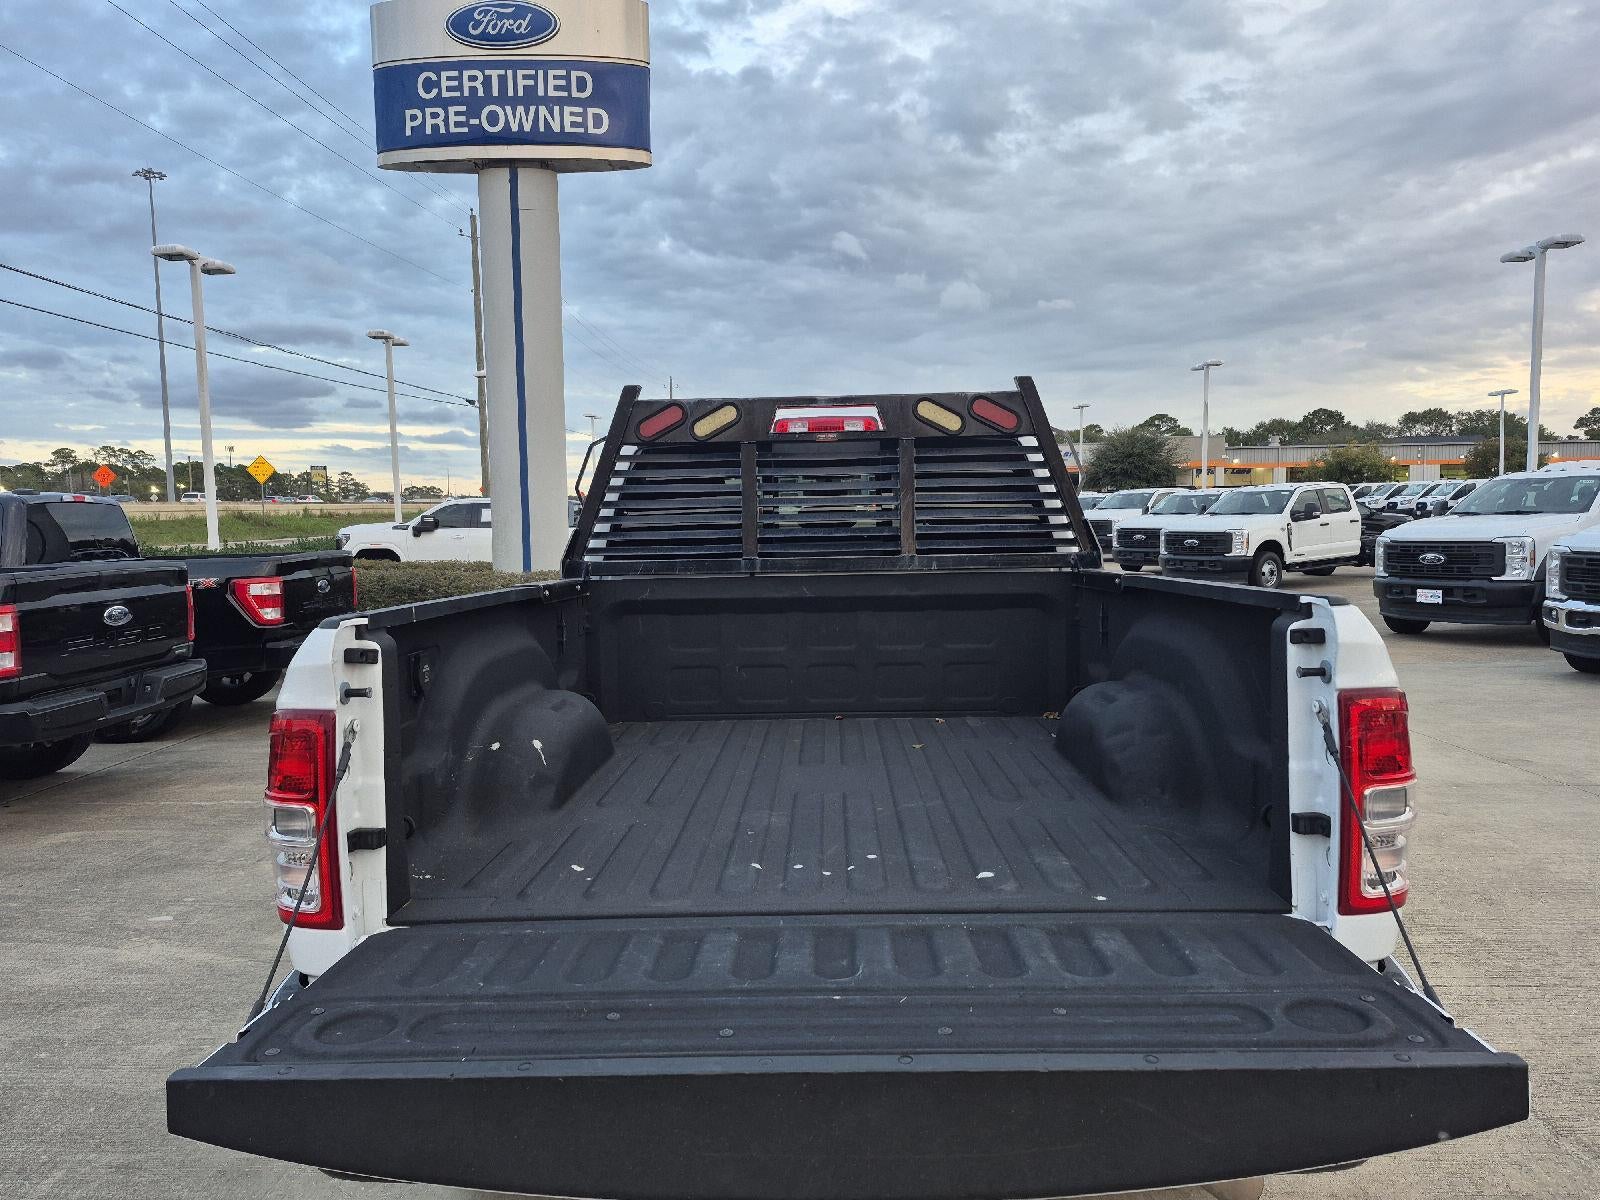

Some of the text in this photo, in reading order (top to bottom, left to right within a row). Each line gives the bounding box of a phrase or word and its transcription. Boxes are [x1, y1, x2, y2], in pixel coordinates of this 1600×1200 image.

[468, 6, 532, 35] Ford
[417, 69, 593, 99] CERTIFIED
[404, 104, 609, 136] PRE-OWNED
